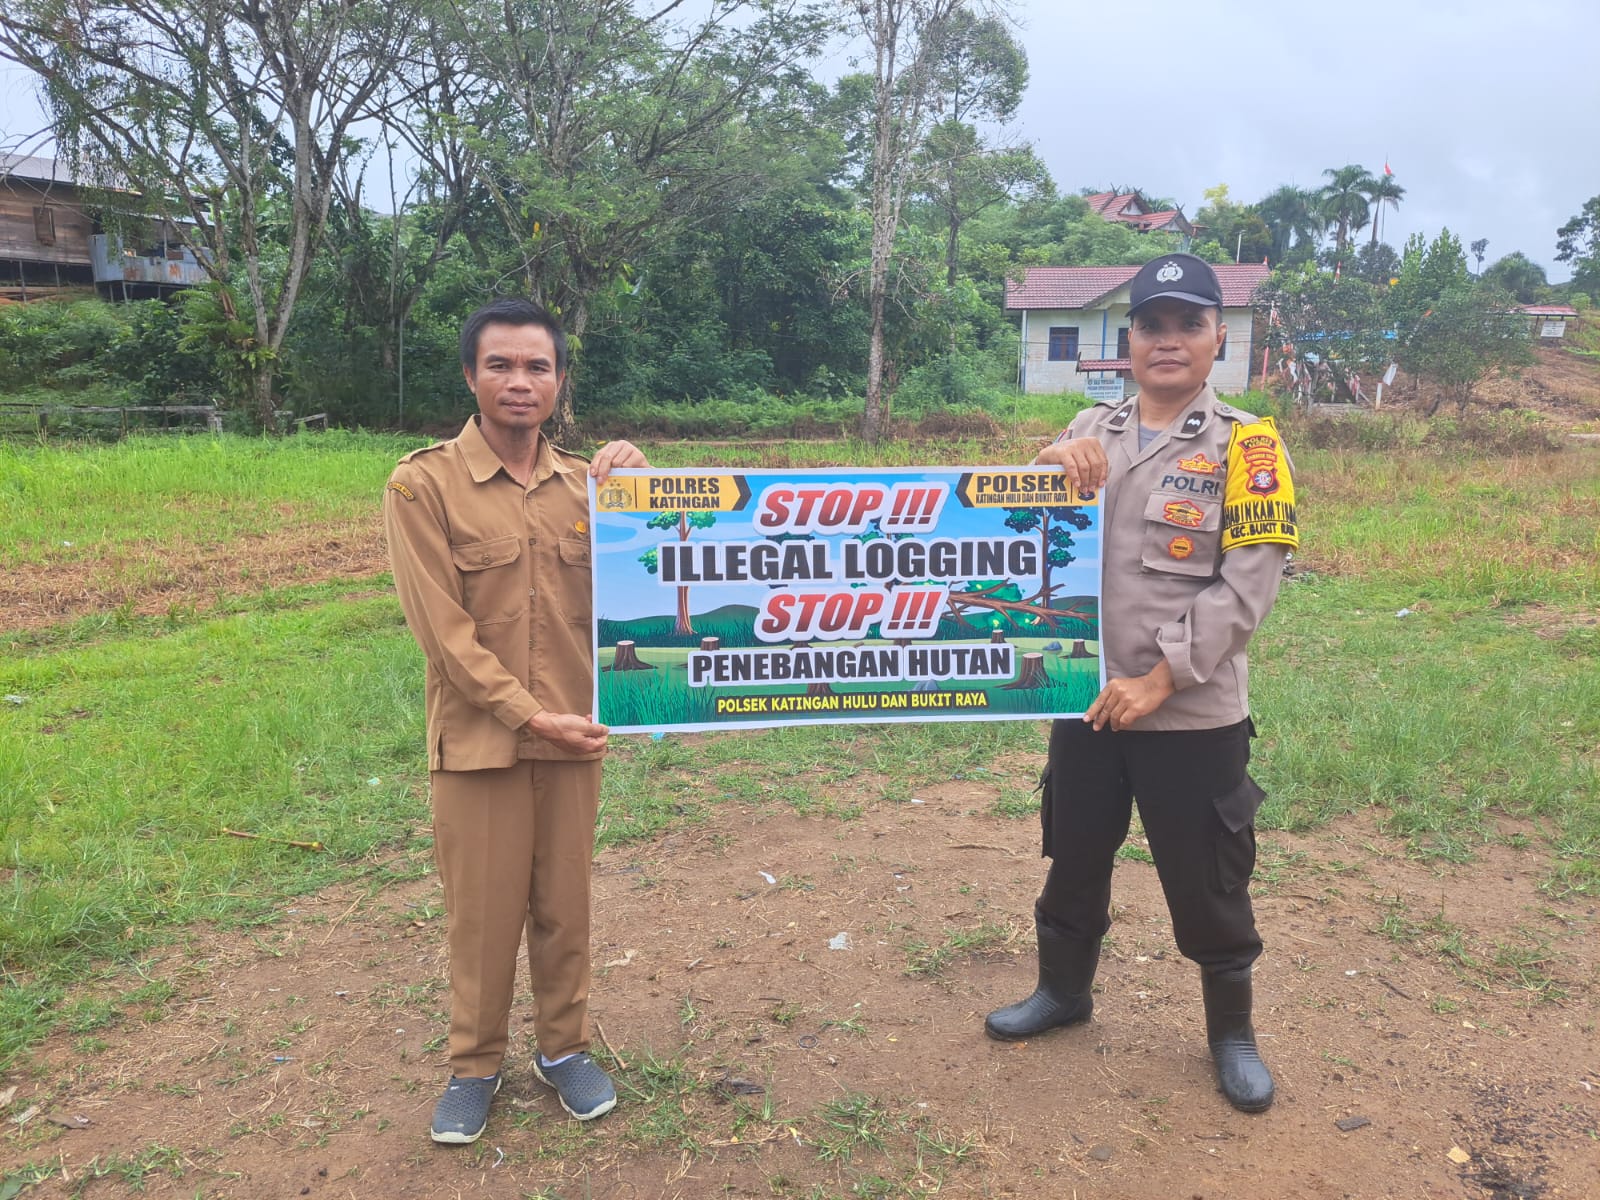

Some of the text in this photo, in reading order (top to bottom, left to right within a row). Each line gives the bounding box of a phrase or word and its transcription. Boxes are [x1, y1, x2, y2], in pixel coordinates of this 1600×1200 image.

[649, 477, 720, 495] POLRES
[977, 475, 1067, 493] POLSEK
[1161, 475, 1220, 496] POLRI
[649, 496, 721, 509] KATINGAN
[976, 493, 1004, 504] KATINGAN
[662, 540, 1037, 582] ILLEGAL LOGGING
[693, 648, 1010, 683] PENEBANGAN HUTAN
[717, 692, 987, 713] POLSEK KATINGAN HULU DAN BUKIT RAYA
